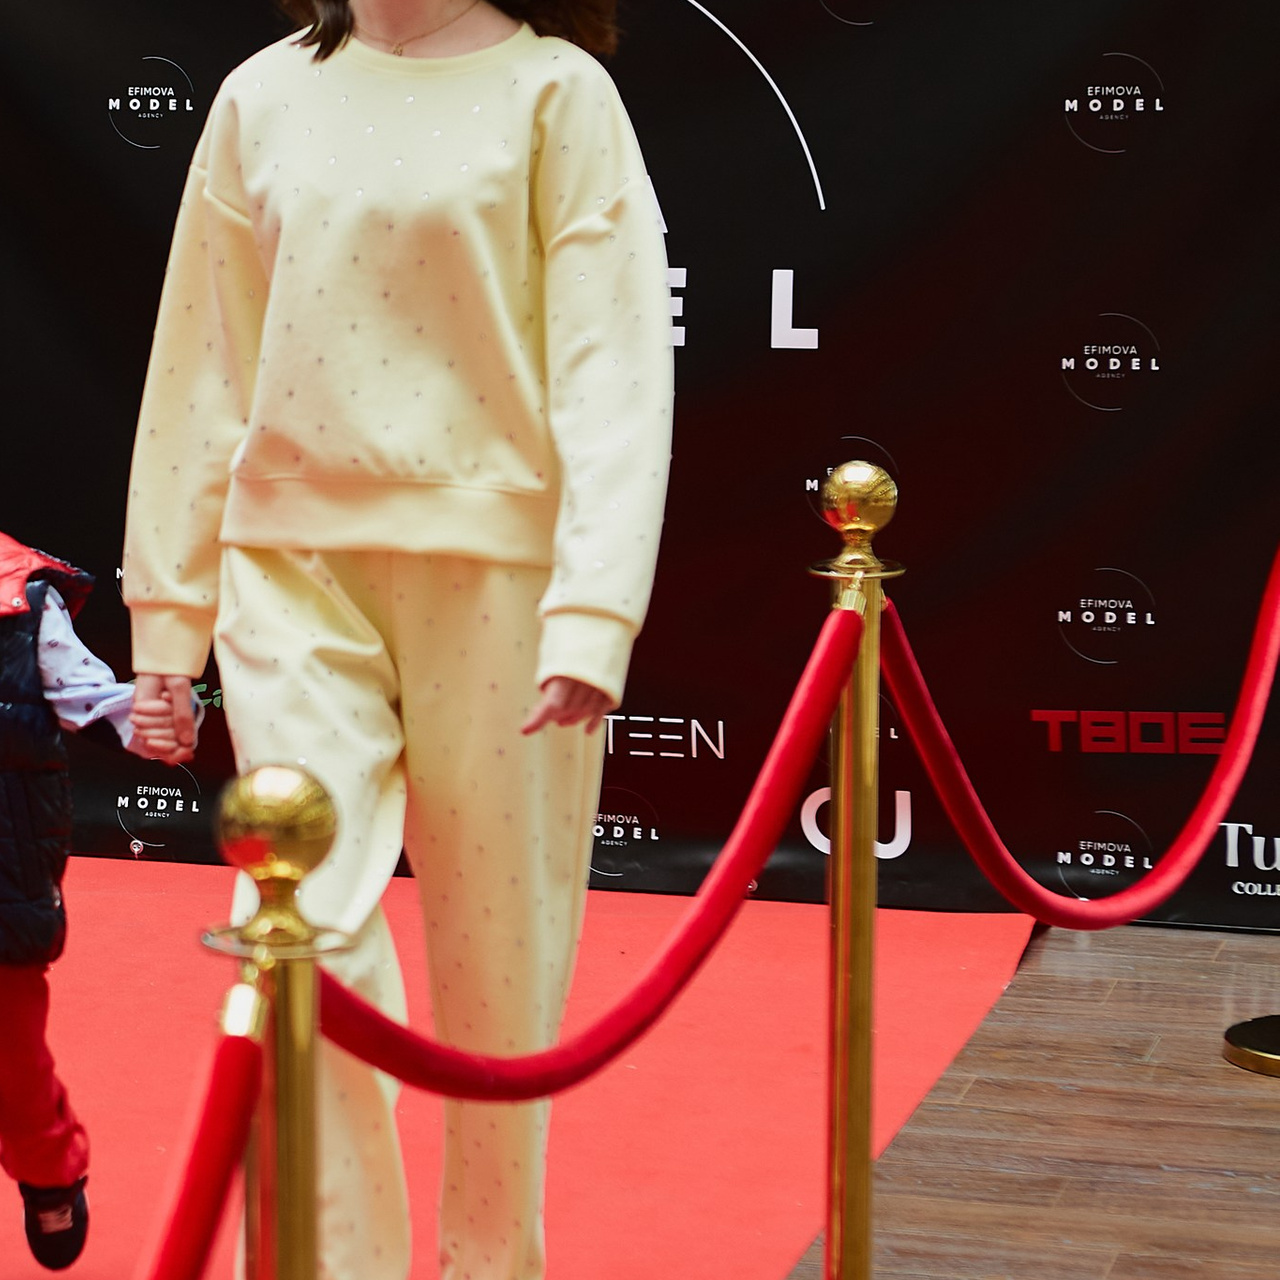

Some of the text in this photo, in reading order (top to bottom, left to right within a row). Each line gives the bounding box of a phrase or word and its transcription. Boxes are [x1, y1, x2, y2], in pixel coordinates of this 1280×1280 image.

[129, 87, 174, 96] EFIMOVA
[1088, 86, 1141, 96] EFIMOVA
[109, 99, 193, 110] MODEL
[1065, 99, 1163, 111] MODEL
[1084, 346, 1137, 354] EFIMOVA
[1062, 358, 1159, 370] MODEL
[1081, 599, 1133, 608] EFIMOVA
[1059, 611, 1154, 624] MODEL
[137, 786, 181, 797] EFIMOVA
[117, 796, 199, 812] MODEL
[592, 825, 659, 840] ODEL
[1080, 841, 1131, 852] EFIMOVA
[1057, 851, 1153, 869] MODEL
